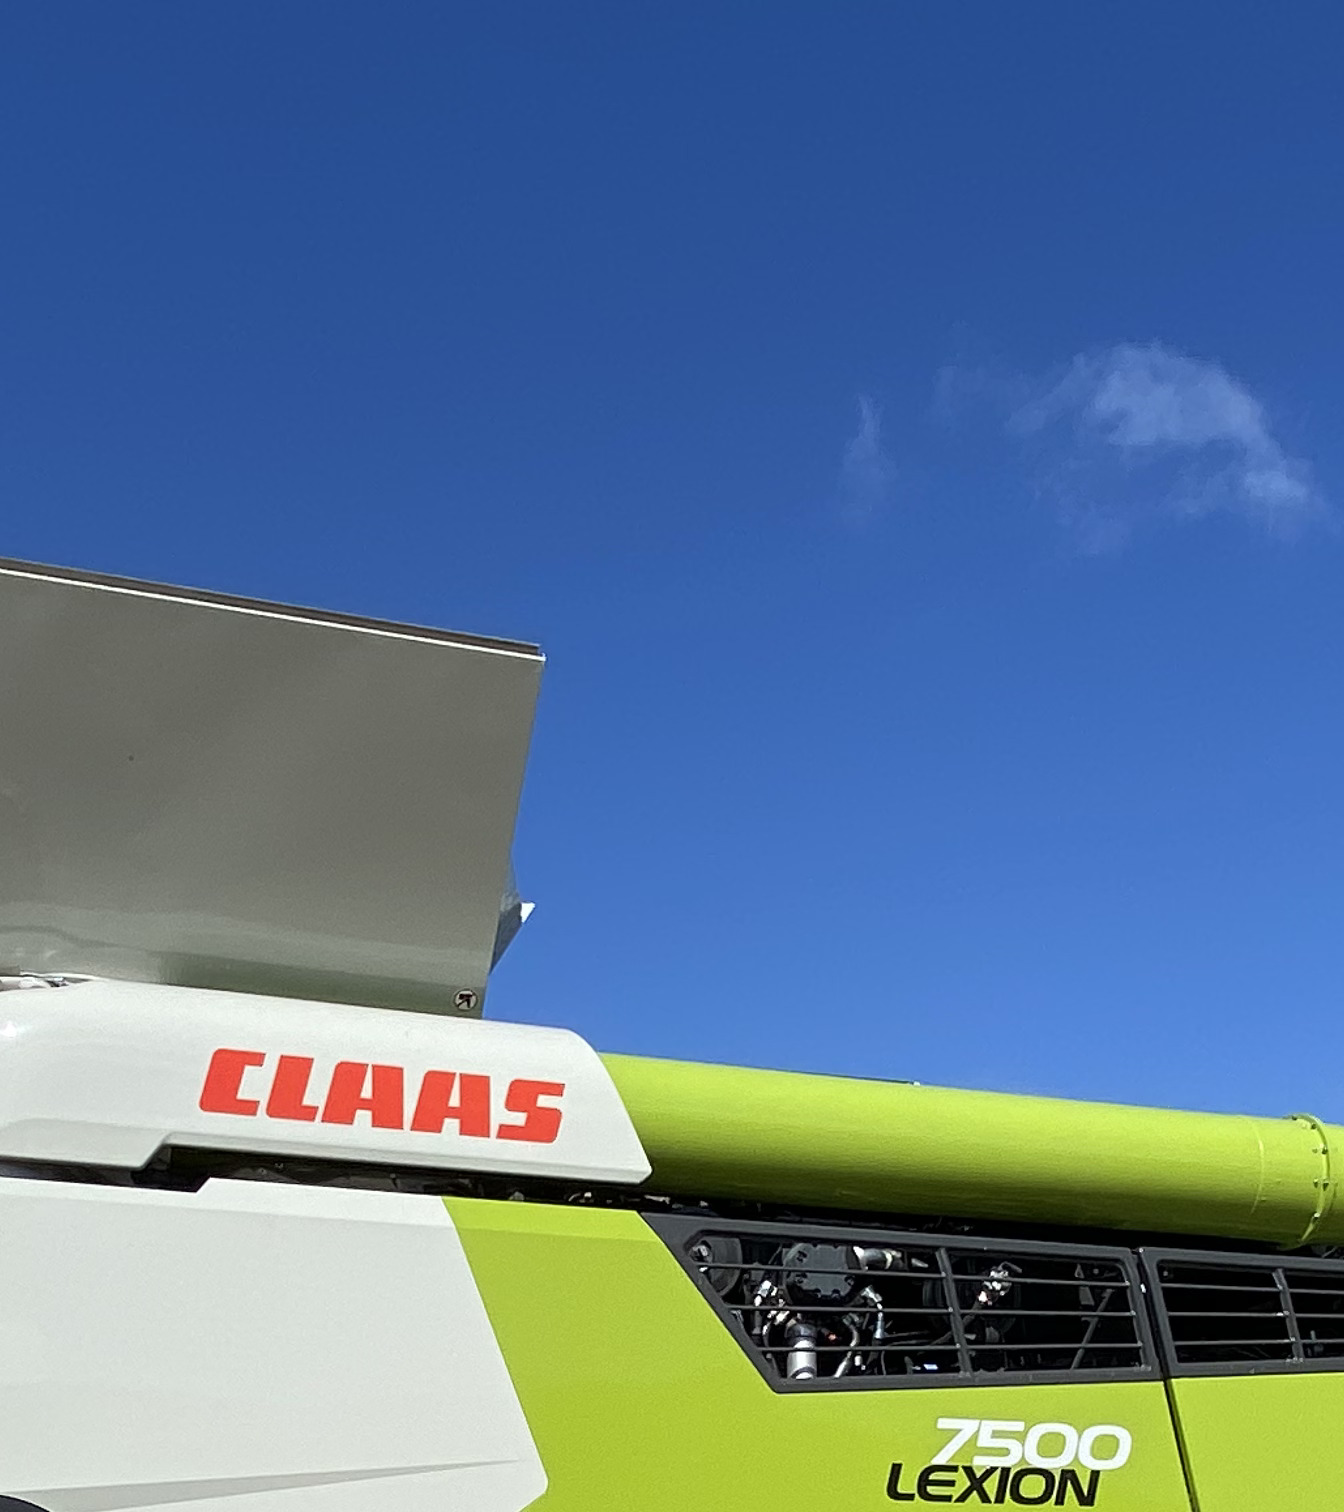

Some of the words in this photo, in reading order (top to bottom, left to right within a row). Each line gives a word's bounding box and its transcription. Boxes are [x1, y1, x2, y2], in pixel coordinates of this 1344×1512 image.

[199, 1048, 565, 1143] CLAAS
[930, 1418, 1133, 1470] 7500
[887, 1463, 1101, 1507] LEXION
